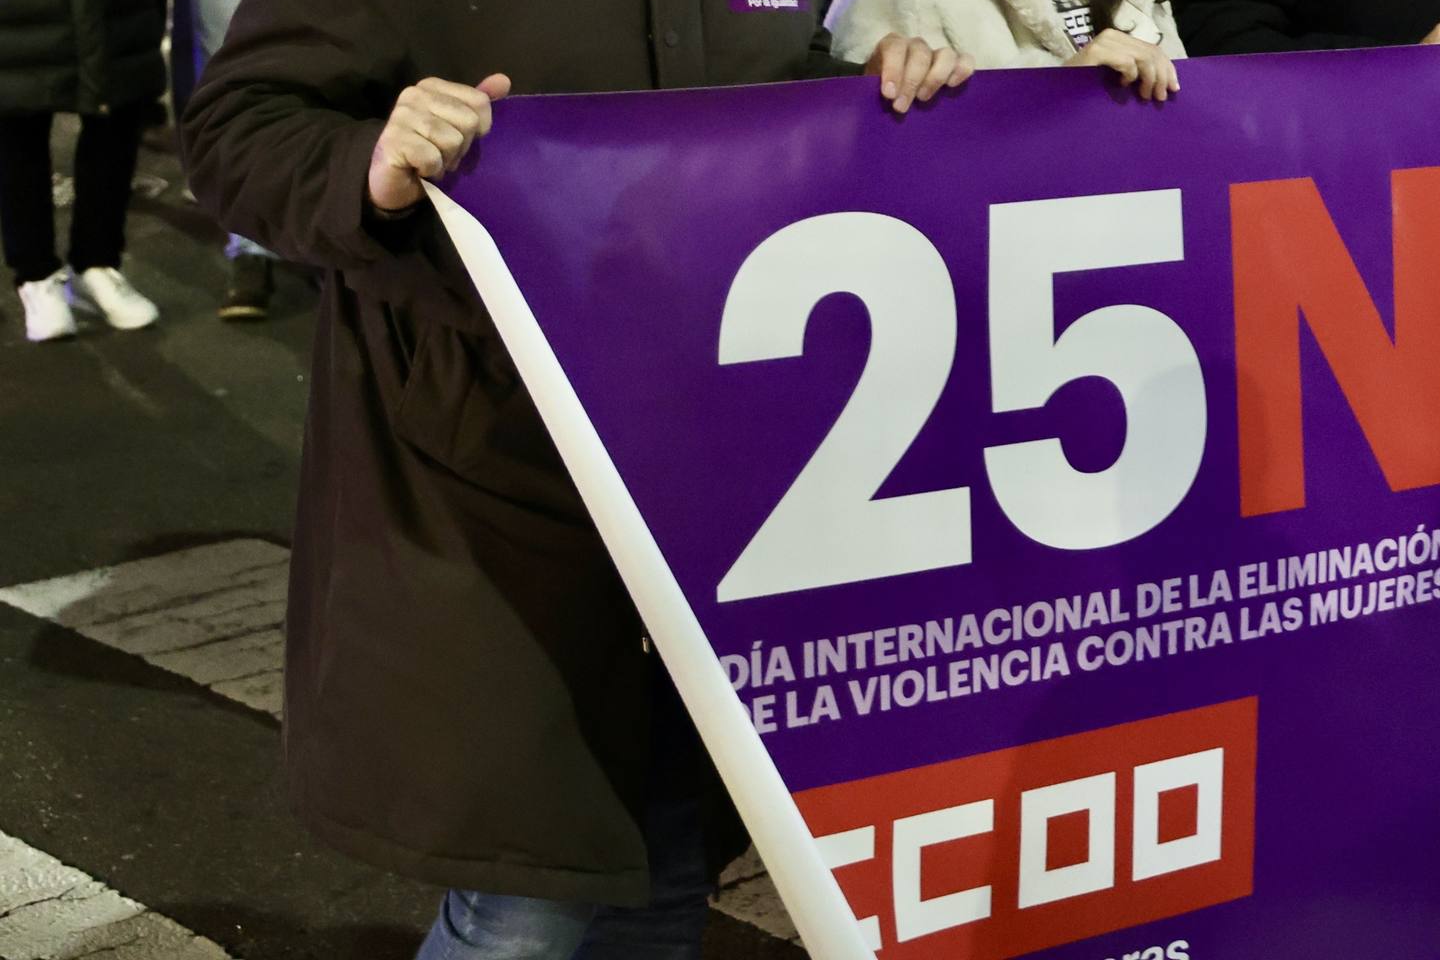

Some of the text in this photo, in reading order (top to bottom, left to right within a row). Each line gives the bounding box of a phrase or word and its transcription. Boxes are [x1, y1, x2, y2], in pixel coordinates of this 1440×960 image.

[719, 640, 796, 691] DÍA
[803, 587, 1130, 679] INTERNACIONAL
[1136, 576, 1183, 619] DE
[1188, 568, 1233, 609] LA
[742, 694, 778, 735] E
[786, 685, 842, 729] LA
[848, 641, 1071, 716] VIOLENCIA
[1076, 611, 1234, 672] CONTRA
[1239, 596, 1303, 640] LAS
